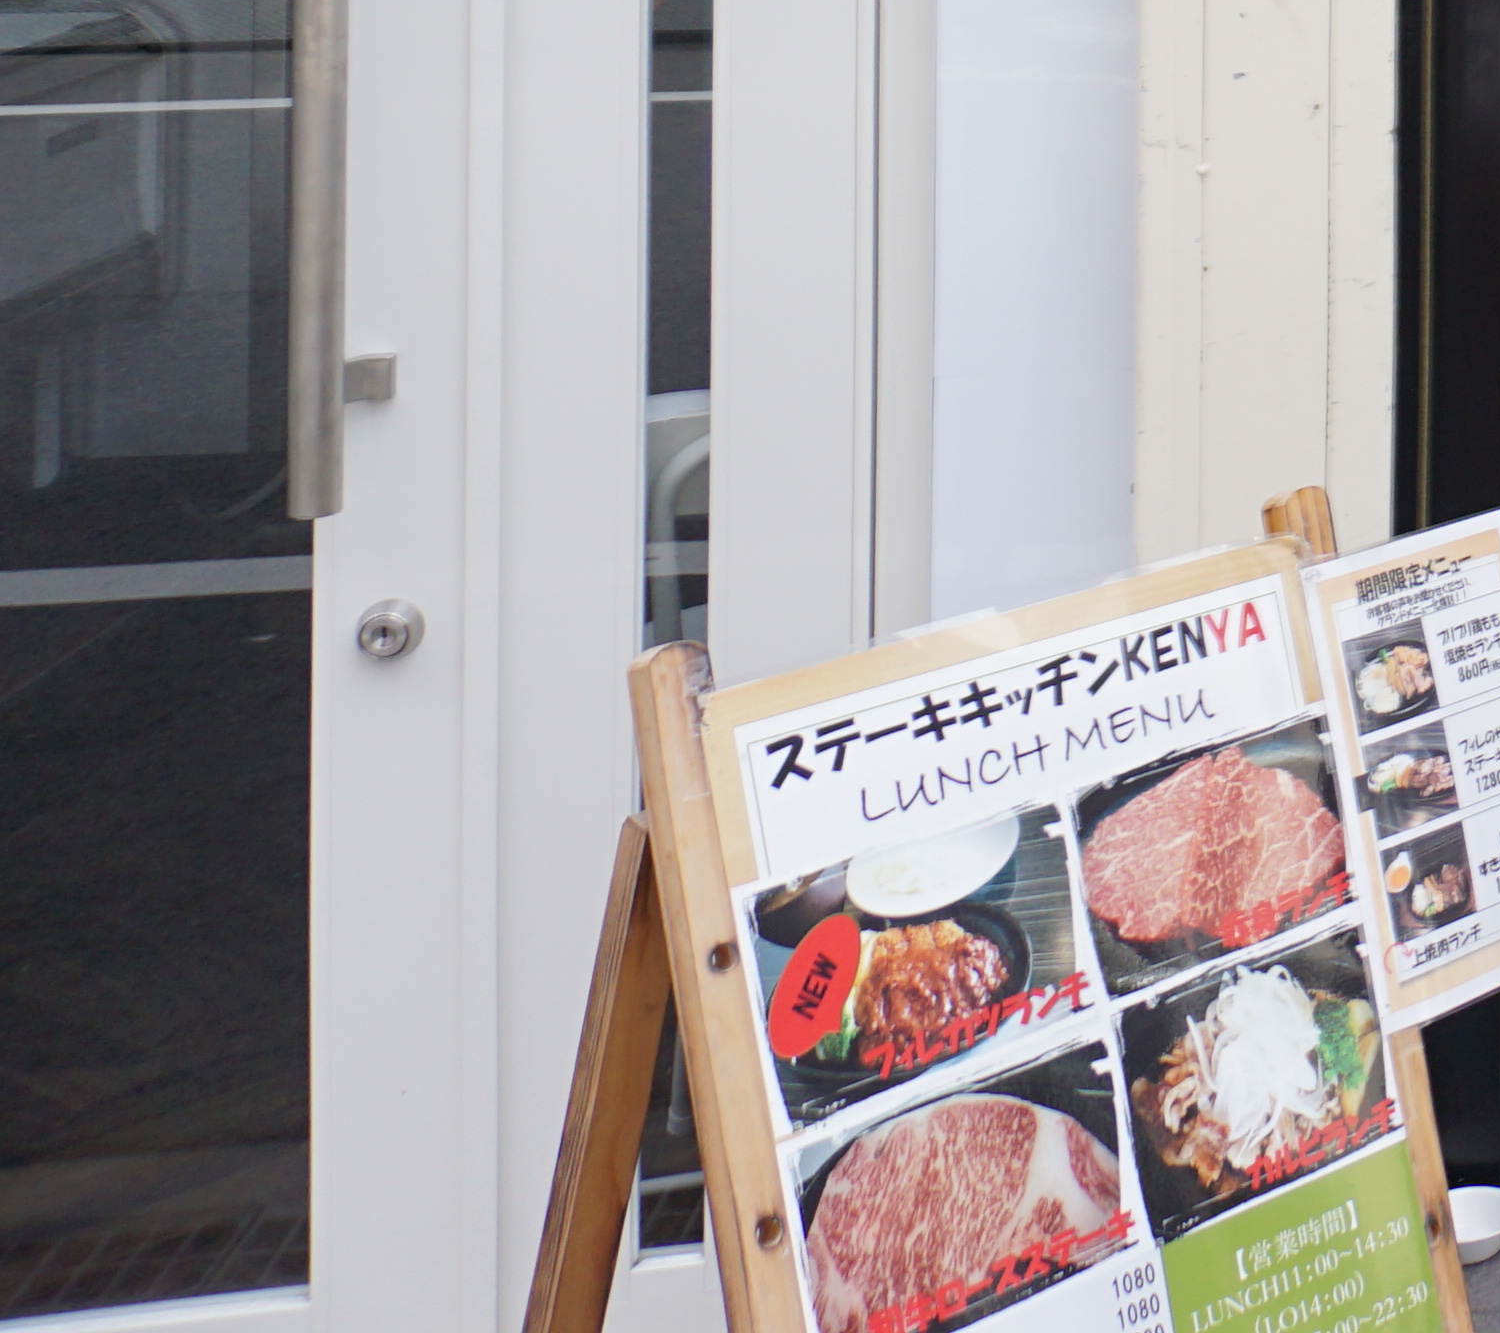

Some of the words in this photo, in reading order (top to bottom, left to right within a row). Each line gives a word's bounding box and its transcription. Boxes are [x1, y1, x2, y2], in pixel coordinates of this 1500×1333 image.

[1355, 554, 1472, 606] 期間限定メニュー
[765, 601, 1267, 790] ステーキキッチンKENYA
[860, 734, 1052, 821] LUNCH
[1064, 688, 1216, 762] MENU
[1411, 923, 1482, 969] 上焼肉ランチ
[791, 952, 838, 1021] NEW
[1245, 1097, 1396, 1191] カルビランチ
[1112, 1261, 1156, 1300] 1080
[1116, 1291, 1161, 1331] 1080
